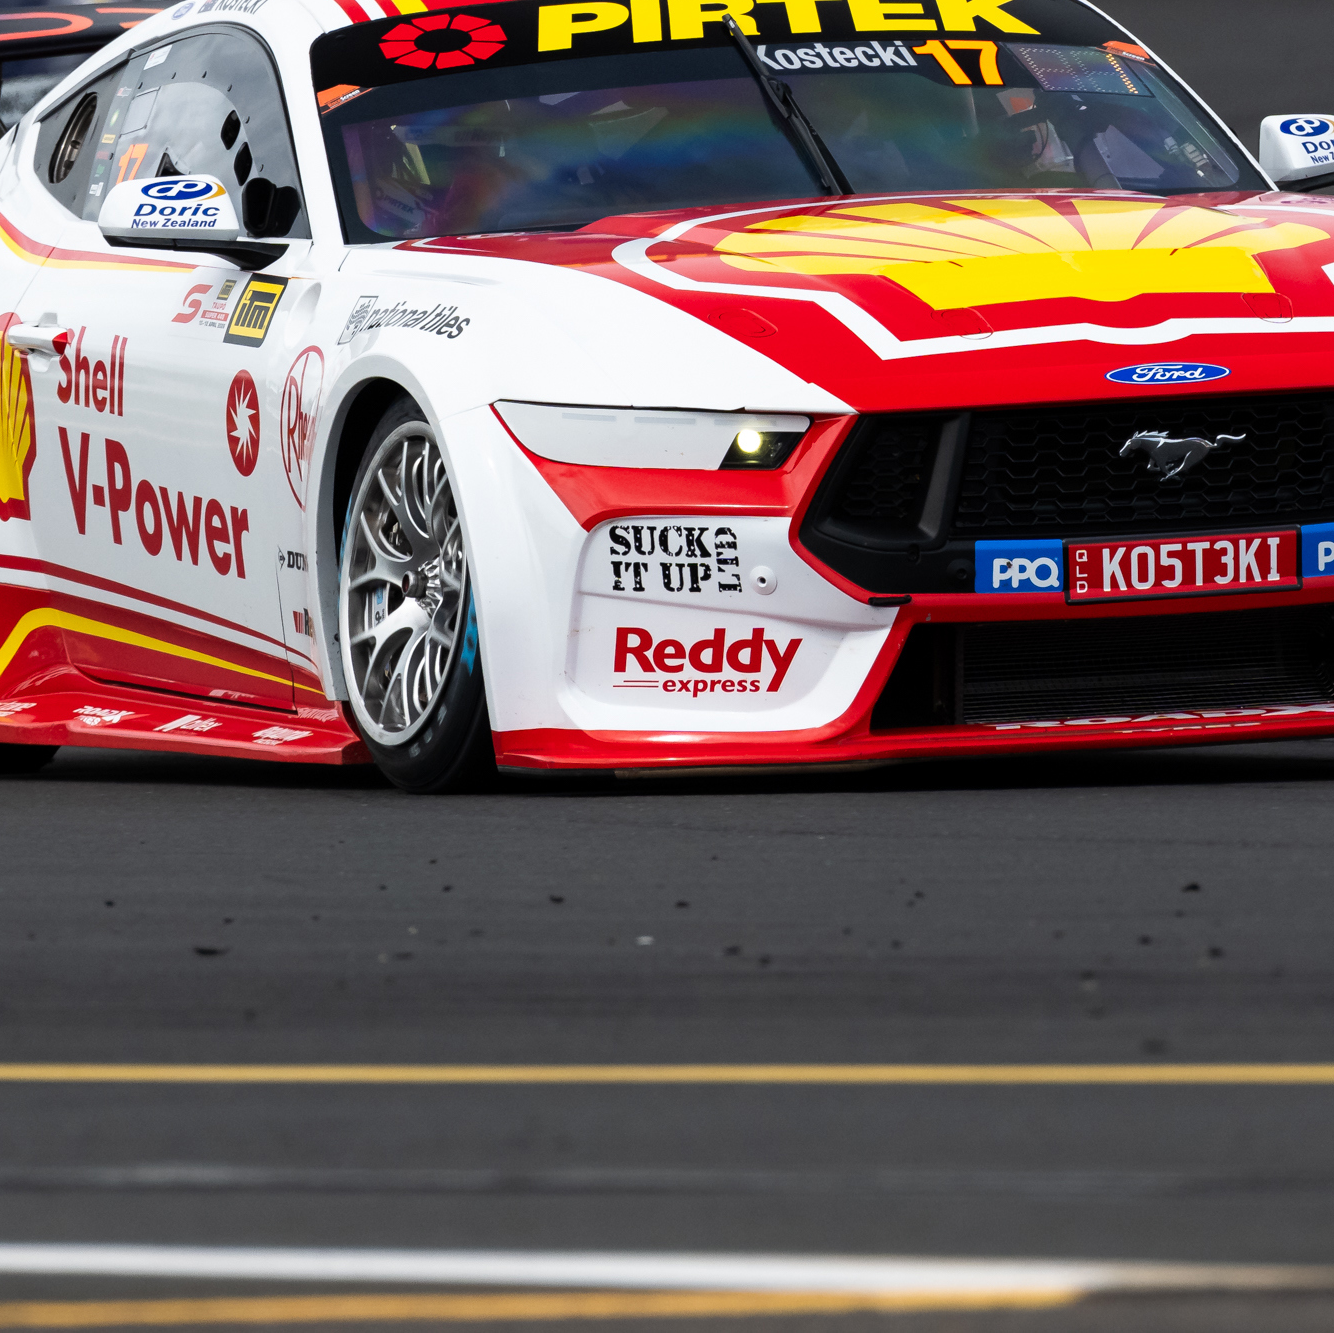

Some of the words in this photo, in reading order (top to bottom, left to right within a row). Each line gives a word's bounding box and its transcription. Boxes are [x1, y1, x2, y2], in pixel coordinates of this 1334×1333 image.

[911, 39, 1005, 87] 17
[116, 143, 150, 186] 17
[1310, 153, 1330, 165] New
[131, 218, 160, 229] New
[161, 218, 218, 228] Zealand
[133, 203, 221, 217] Doric
[359, 303, 441, 332] national
[420, 304, 471, 339] tiles
[57, 325, 129, 417] Shell
[1132, 365, 1206, 382] Ford
[57, 425, 250, 580] V-Power
[609, 525, 712, 558] SUCK
[610, 560, 649, 592] IT
[659, 562, 712, 593] UP
[714, 526, 743, 593] LTD
[992, 556, 1060, 589] PPQ
[1075, 549, 1089, 594] QLD
[613, 626, 804, 693] Reddy
[662, 678, 761, 699] express
